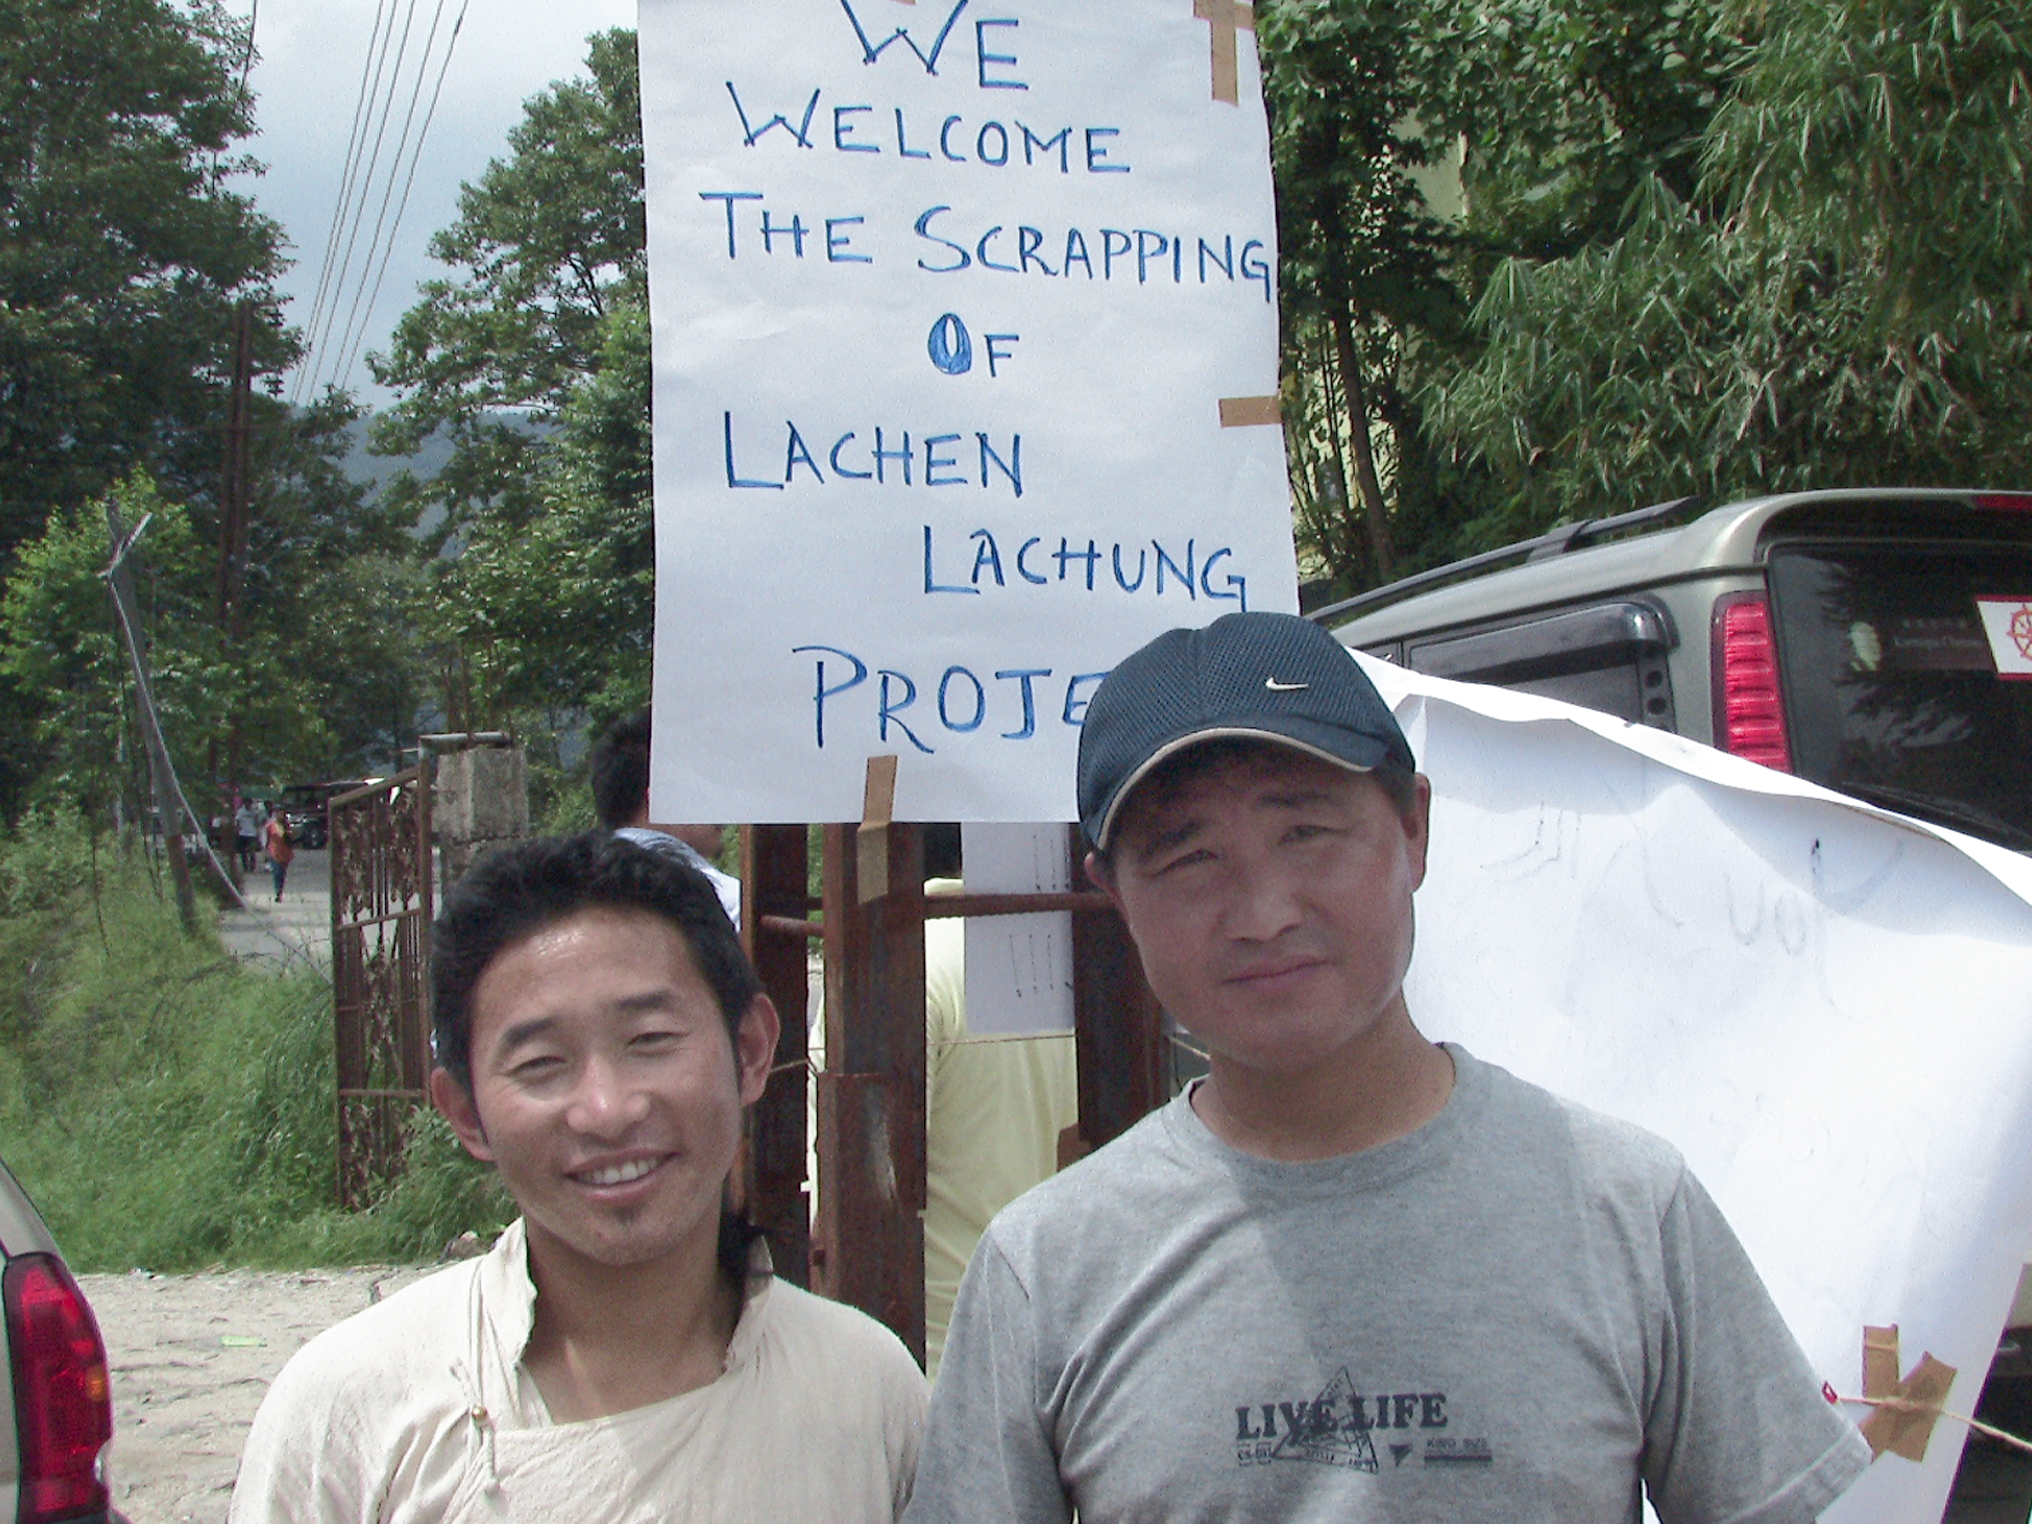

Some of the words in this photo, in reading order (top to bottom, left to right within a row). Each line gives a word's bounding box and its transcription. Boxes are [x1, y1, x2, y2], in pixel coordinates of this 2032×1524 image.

[842, 0, 1029, 89] WE
[726, 79, 1130, 172] WELCOME
[700, 191, 872, 262] THE
[915, 204, 1271, 302] SCRAPPING
[928, 312, 1020, 376] OF
[725, 411, 1023, 497] LACHEN
[925, 525, 1246, 612] LACHUNG
[793, 646, 1111, 754] PROJE
[1235, 1400, 1338, 1443] LIVE
[1341, 1392, 1449, 1431] LIFE
